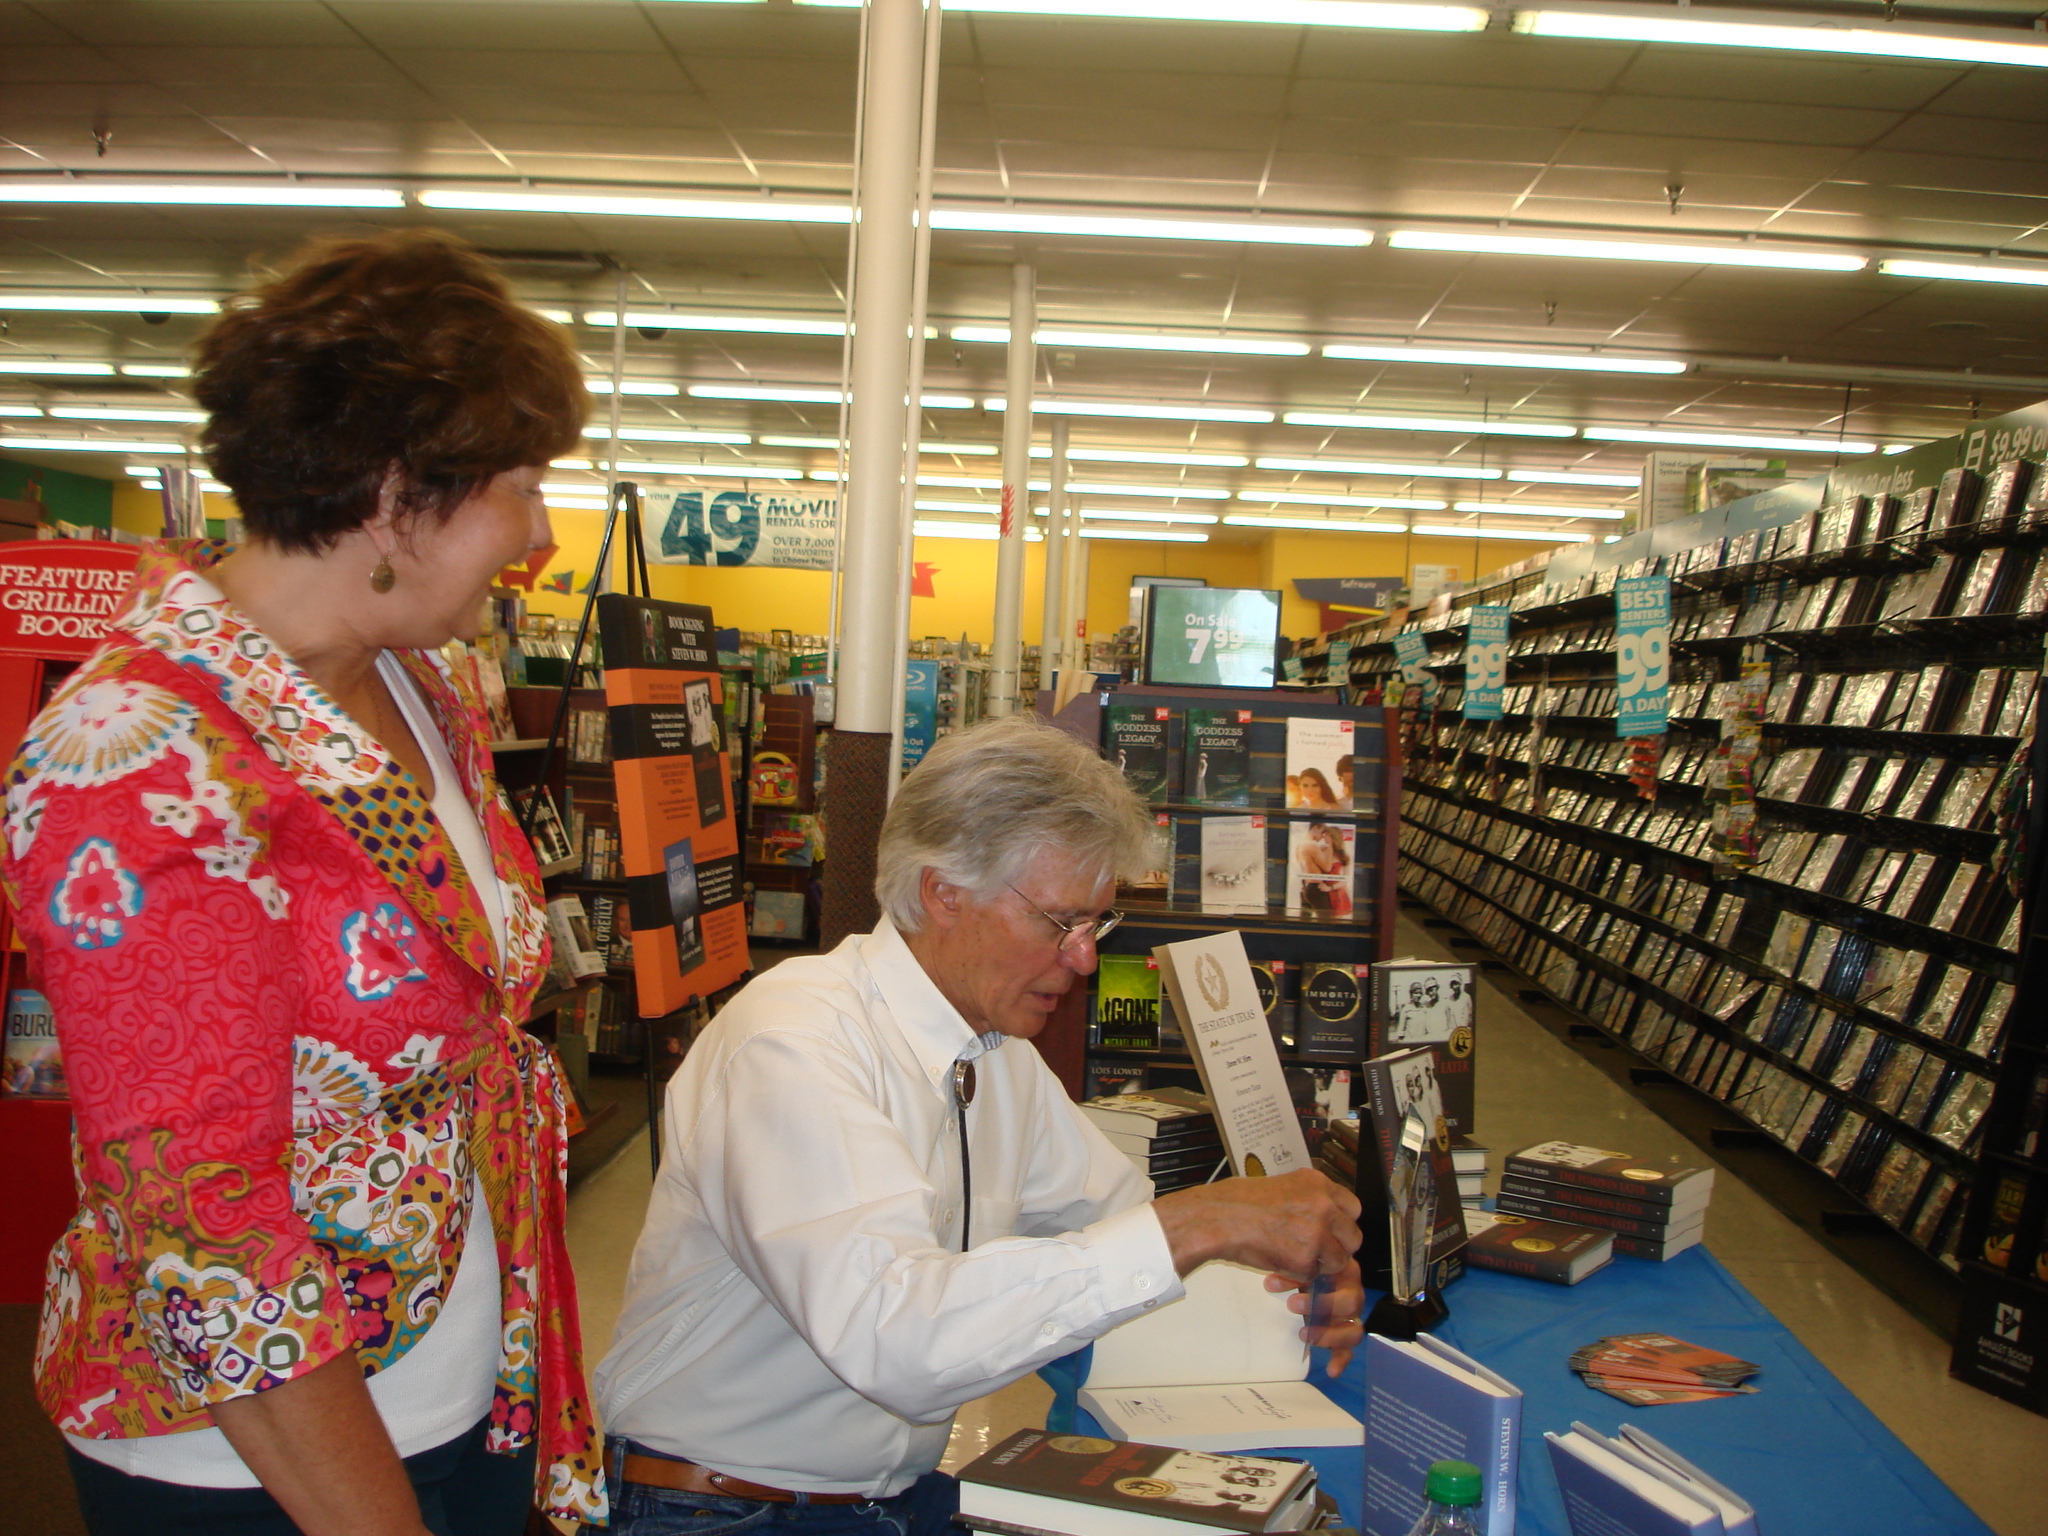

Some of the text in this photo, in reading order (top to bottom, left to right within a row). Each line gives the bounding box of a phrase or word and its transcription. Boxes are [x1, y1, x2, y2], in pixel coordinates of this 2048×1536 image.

[1989, 425, 2032, 466] $9.99
[766, 517, 836, 529] RENTAL STOR
[773, 536, 835, 548] OVER 7,000
[792, 548, 834, 557] FAVORITES
[2, 588, 124, 615] GRILLIN
[1620, 590, 1667, 610] BEST
[1185, 613, 1237, 627] On Sale
[1472, 614, 1507, 628] BEST
[1620, 608, 1667, 622] RENTERS
[1467, 692, 1503, 703] A DAY
[1622, 696, 1667, 713] A DAY
[1111, 997, 1159, 1024] GONE
[1198, 1021, 1209, 1033] THE
[1209, 1017, 1228, 1031] STATE
[1235, 1009, 1256, 1023] TEXAS
[1092, 1066, 1144, 1076] LOIS LOWRY
[1500, 1417, 1511, 1460] STEVEN
[1496, 1481, 1507, 1513] HORN
